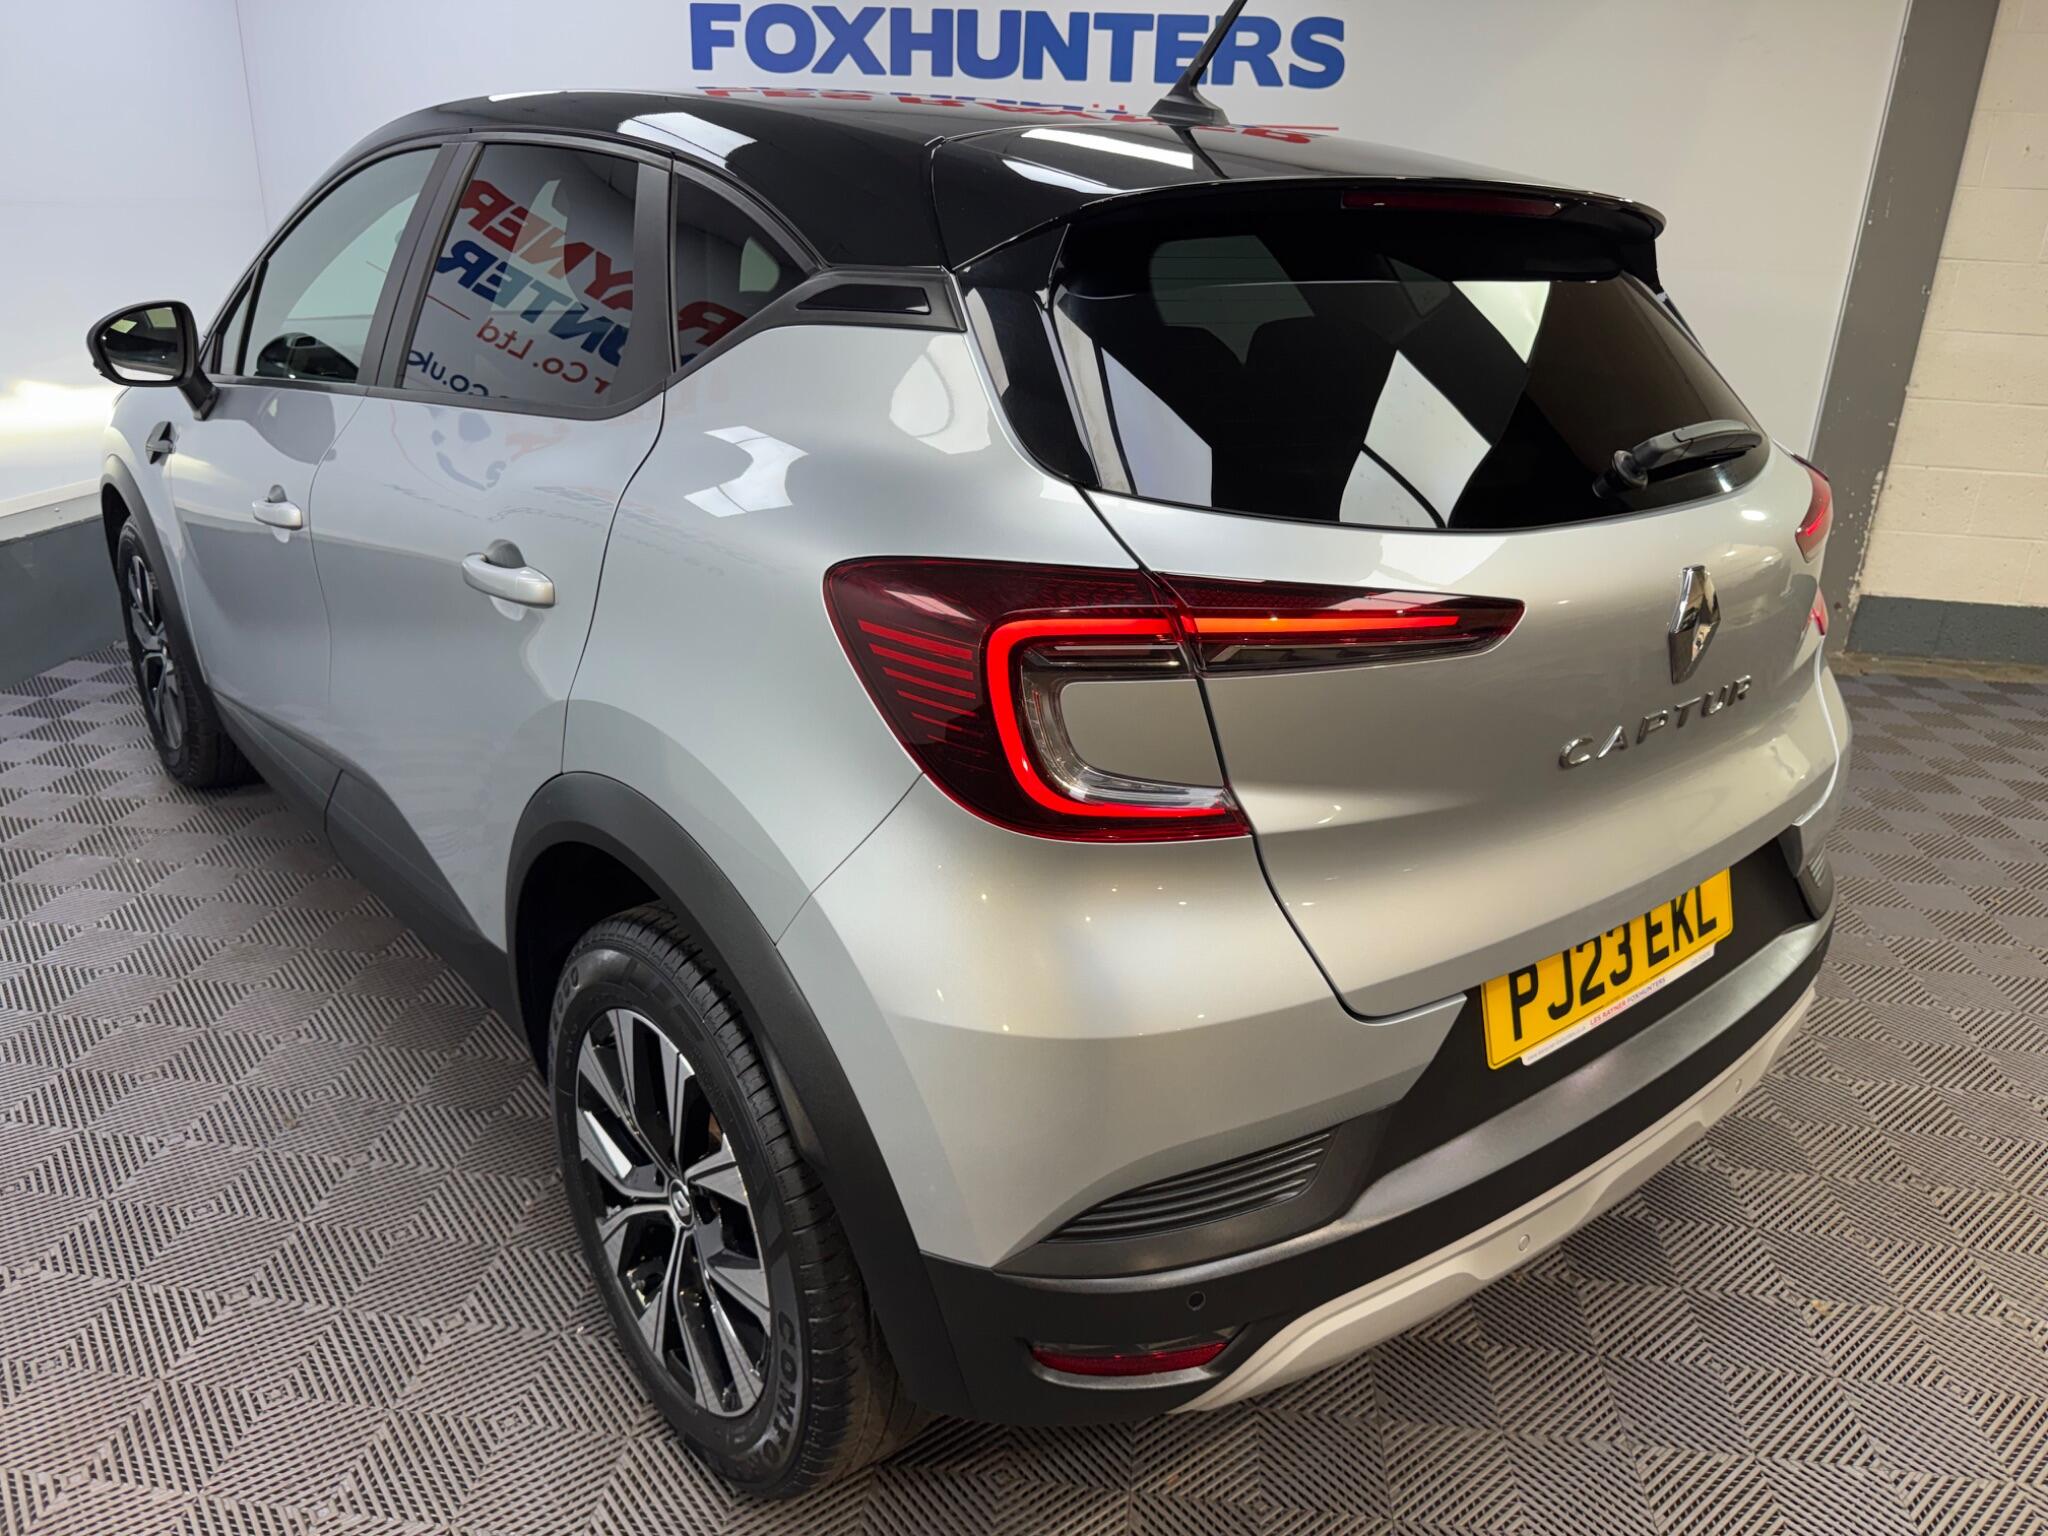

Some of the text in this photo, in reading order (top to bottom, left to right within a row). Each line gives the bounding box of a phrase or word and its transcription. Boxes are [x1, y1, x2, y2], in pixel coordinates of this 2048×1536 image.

[690, 3, 1345, 89] FOXHUNTERS
[1559, 674, 1752, 768] CAPTUR
[1508, 884, 1717, 1042] PJ23 EKL
